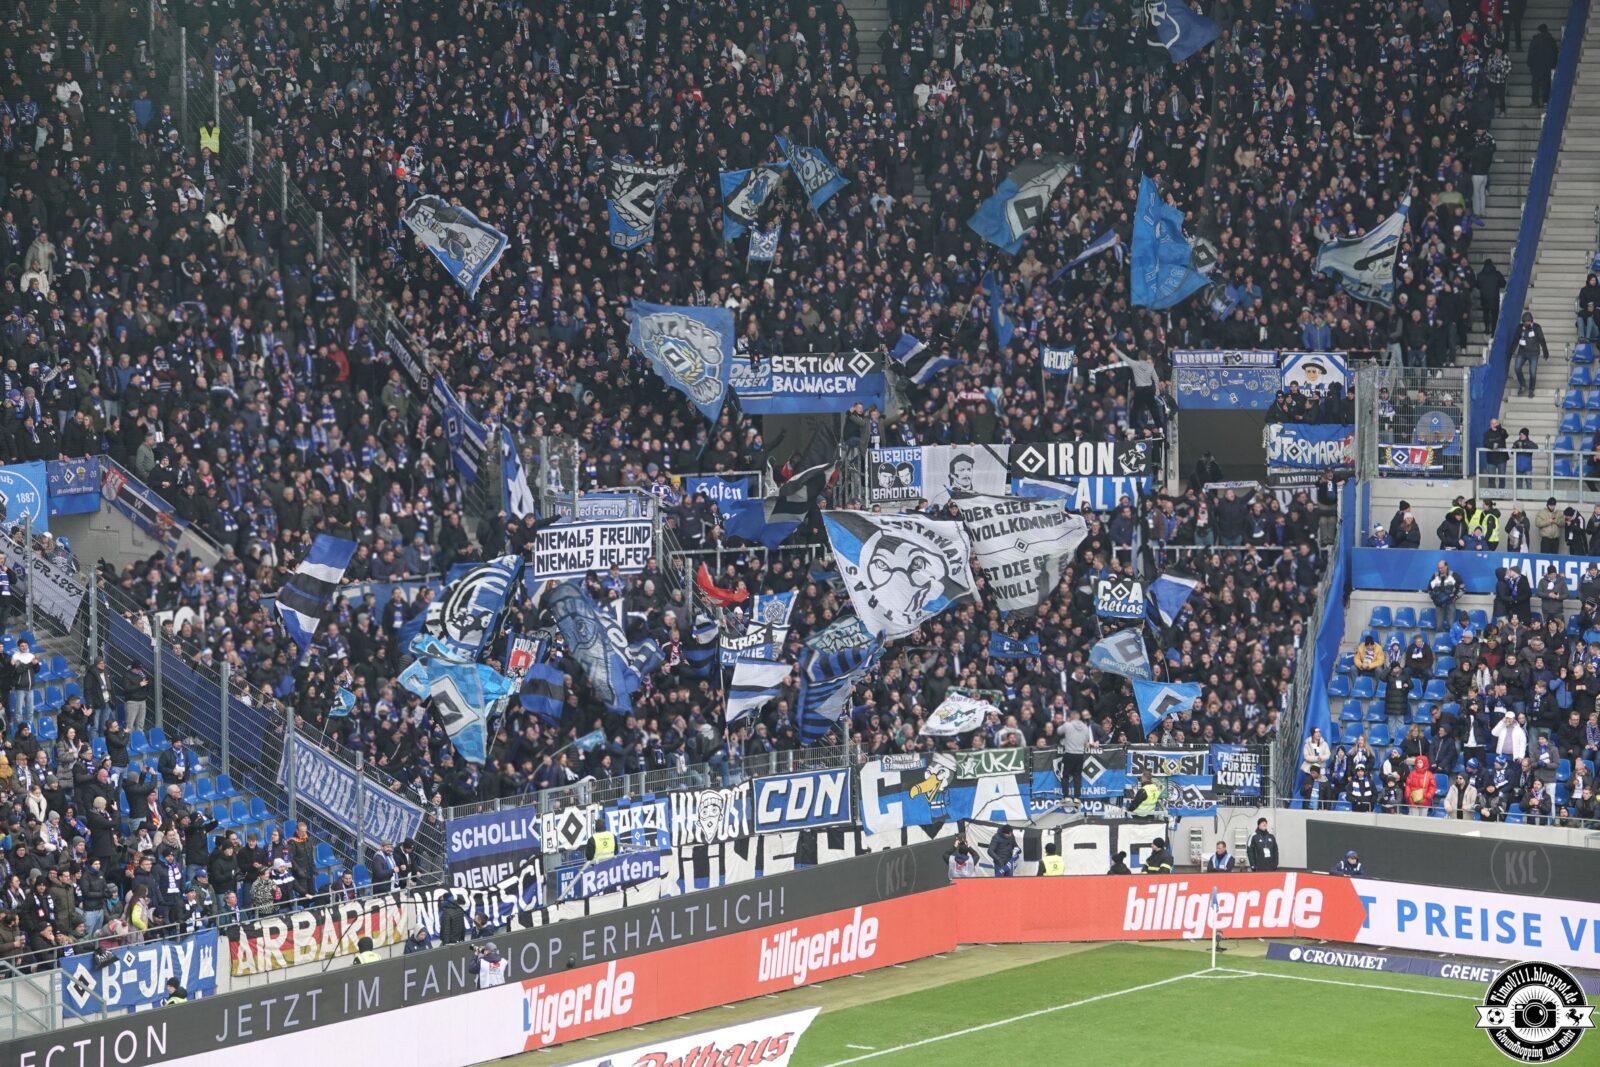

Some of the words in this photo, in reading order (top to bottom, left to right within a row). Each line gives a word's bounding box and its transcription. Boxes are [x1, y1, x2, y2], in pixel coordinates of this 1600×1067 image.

[772, 355, 844, 374] SEKTION
[772, 376, 856, 393] BAUWAGEN
[872, 450, 922, 463] BIERIGE
[1048, 442, 1115, 476] IRON
[16, 492, 35, 503] 1887
[872, 487, 921, 499] BANDITEN
[592, 503, 624, 517] Family
[536, 528, 593, 551] NIEMALS
[600, 525, 650, 546] FREUND
[536, 549, 593, 573] NIEMALS
[599, 547, 650, 567] HELFER
[1002, 558, 1031, 579] DIE
[720, 629, 766, 651] ULTRAS
[1217, 751, 1260, 764] FREIHEIT
[1221, 761, 1238, 771] FÜR
[1240, 763, 1257, 772] DIE
[1217, 771, 1261, 787] KURVE
[606, 802, 669, 835] FORZA
[451, 818, 527, 853] SCHOLLI
[582, 859, 660, 897] Rauten-
[1504, 850, 1539, 886] KSC
[1123, 871, 1324, 939] billiger.de
[1397, 899, 1543, 948] PREISE
[758, 905, 879, 985] billiger.de
[216, 988, 323, 1041] JETZT
[344, 976, 380, 1014] IM
[583, 886, 786, 960] ERHÄLTLICH!
[1303, 949, 1387, 971] CRONIMET
[103, 941, 194, 1006] B-JAY
